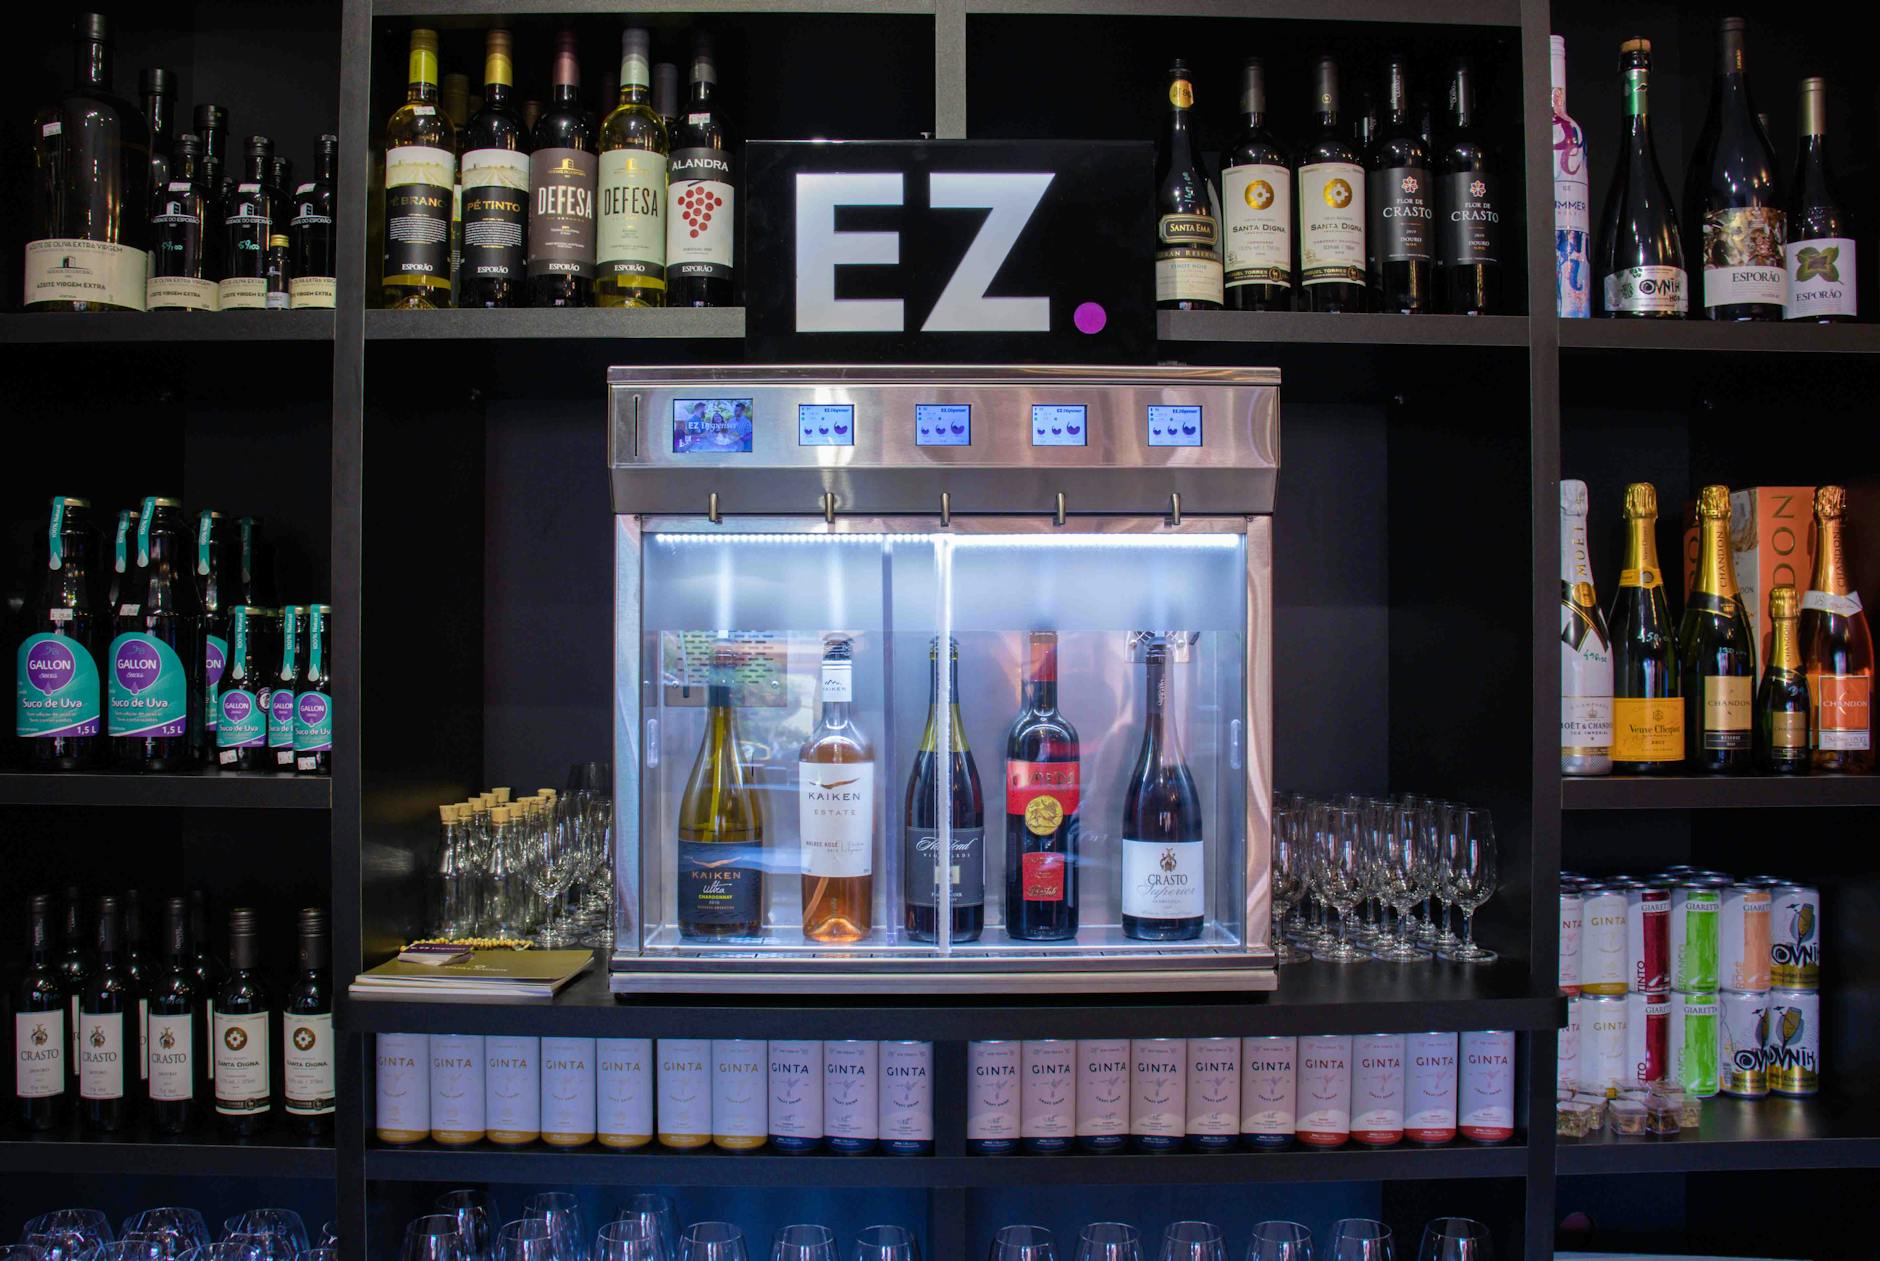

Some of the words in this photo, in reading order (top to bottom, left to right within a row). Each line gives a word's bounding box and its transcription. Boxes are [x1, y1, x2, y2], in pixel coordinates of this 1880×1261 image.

[671, 158, 729, 172] ALANDRA
[467, 200, 481, 212] PÉ
[482, 199, 520, 213] TINTO
[537, 185, 592, 219] DEFESA
[604, 186, 658, 217] DEFESA
[1382, 206, 1432, 220] CRASTO
[1451, 210, 1499, 223] CRASTO
[1170, 224, 1195, 232] SANTA
[1196, 224, 1211, 234] EMA
[1232, 224, 1259, 233] SANTA
[1262, 224, 1286, 233] DIGNA
[1341, 222, 1362, 232] DIGNA
[401, 263, 434, 272] ESPORÃO
[477, 264, 508, 274] ESPORÃO
[548, 262, 580, 272] ESPORÃO
[614, 263, 646, 272] ESPORÃO
[681, 264, 713, 273] ESPORÃO
[1732, 271, 1780, 283] ESPORÃO
[1796, 290, 1842, 302] ESPORÃO
[1718, 531, 1726, 588] CHANDON
[30, 660, 71, 670] GALLON
[118, 659, 157, 670] GALLON
[22, 698, 42, 708] Suco
[44, 698, 58, 708] de
[60, 698, 82, 708] Uva
[112, 697, 130, 707] Suco
[131, 698, 144, 707] de
[146, 697, 168, 707] Uva
[77, 726, 90, 735] 1,5
[162, 726, 175, 734] 1,5
[1629, 724, 1653, 734] Veuve
[808, 792, 860, 800] KAIKEN
[1148, 874, 1188, 886] CRASTO
[1591, 916, 1626, 926] GINTA
[1637, 960, 1645, 992] TINTO
[20, 1049, 59, 1062] CRASTO
[82, 1052, 117, 1063] CRASTO
[152, 1053, 186, 1064] CRASTO
[1468, 1054, 1508, 1065] GINTA
[379, 1056, 415, 1067] GINTA
[434, 1058, 472, 1068] GINTA
[489, 1058, 527, 1068] GINTA
[546, 1060, 585, 1070] GINTA
[1251, 1061, 1291, 1071] GINTA
[1305, 1058, 1344, 1070] GINTA
[1362, 1058, 1400, 1069] GINTA
[1416, 1056, 1454, 1066] GINTA
[602, 1061, 641, 1072] GINTA
[663, 1062, 703, 1072] GINTA
[720, 1063, 758, 1073] GINTA
[771, 1062, 809, 1074] GINTA
[828, 1064, 866, 1075] GINTA
[887, 1066, 926, 1076] GINTA
[976, 1065, 1016, 1076] GINTA
[1032, 1064, 1071, 1074] GINTA
[1089, 1062, 1126, 1072] GINTA
[1138, 1062, 1177, 1074] GINTA
[1195, 1062, 1234, 1072] GINTA
